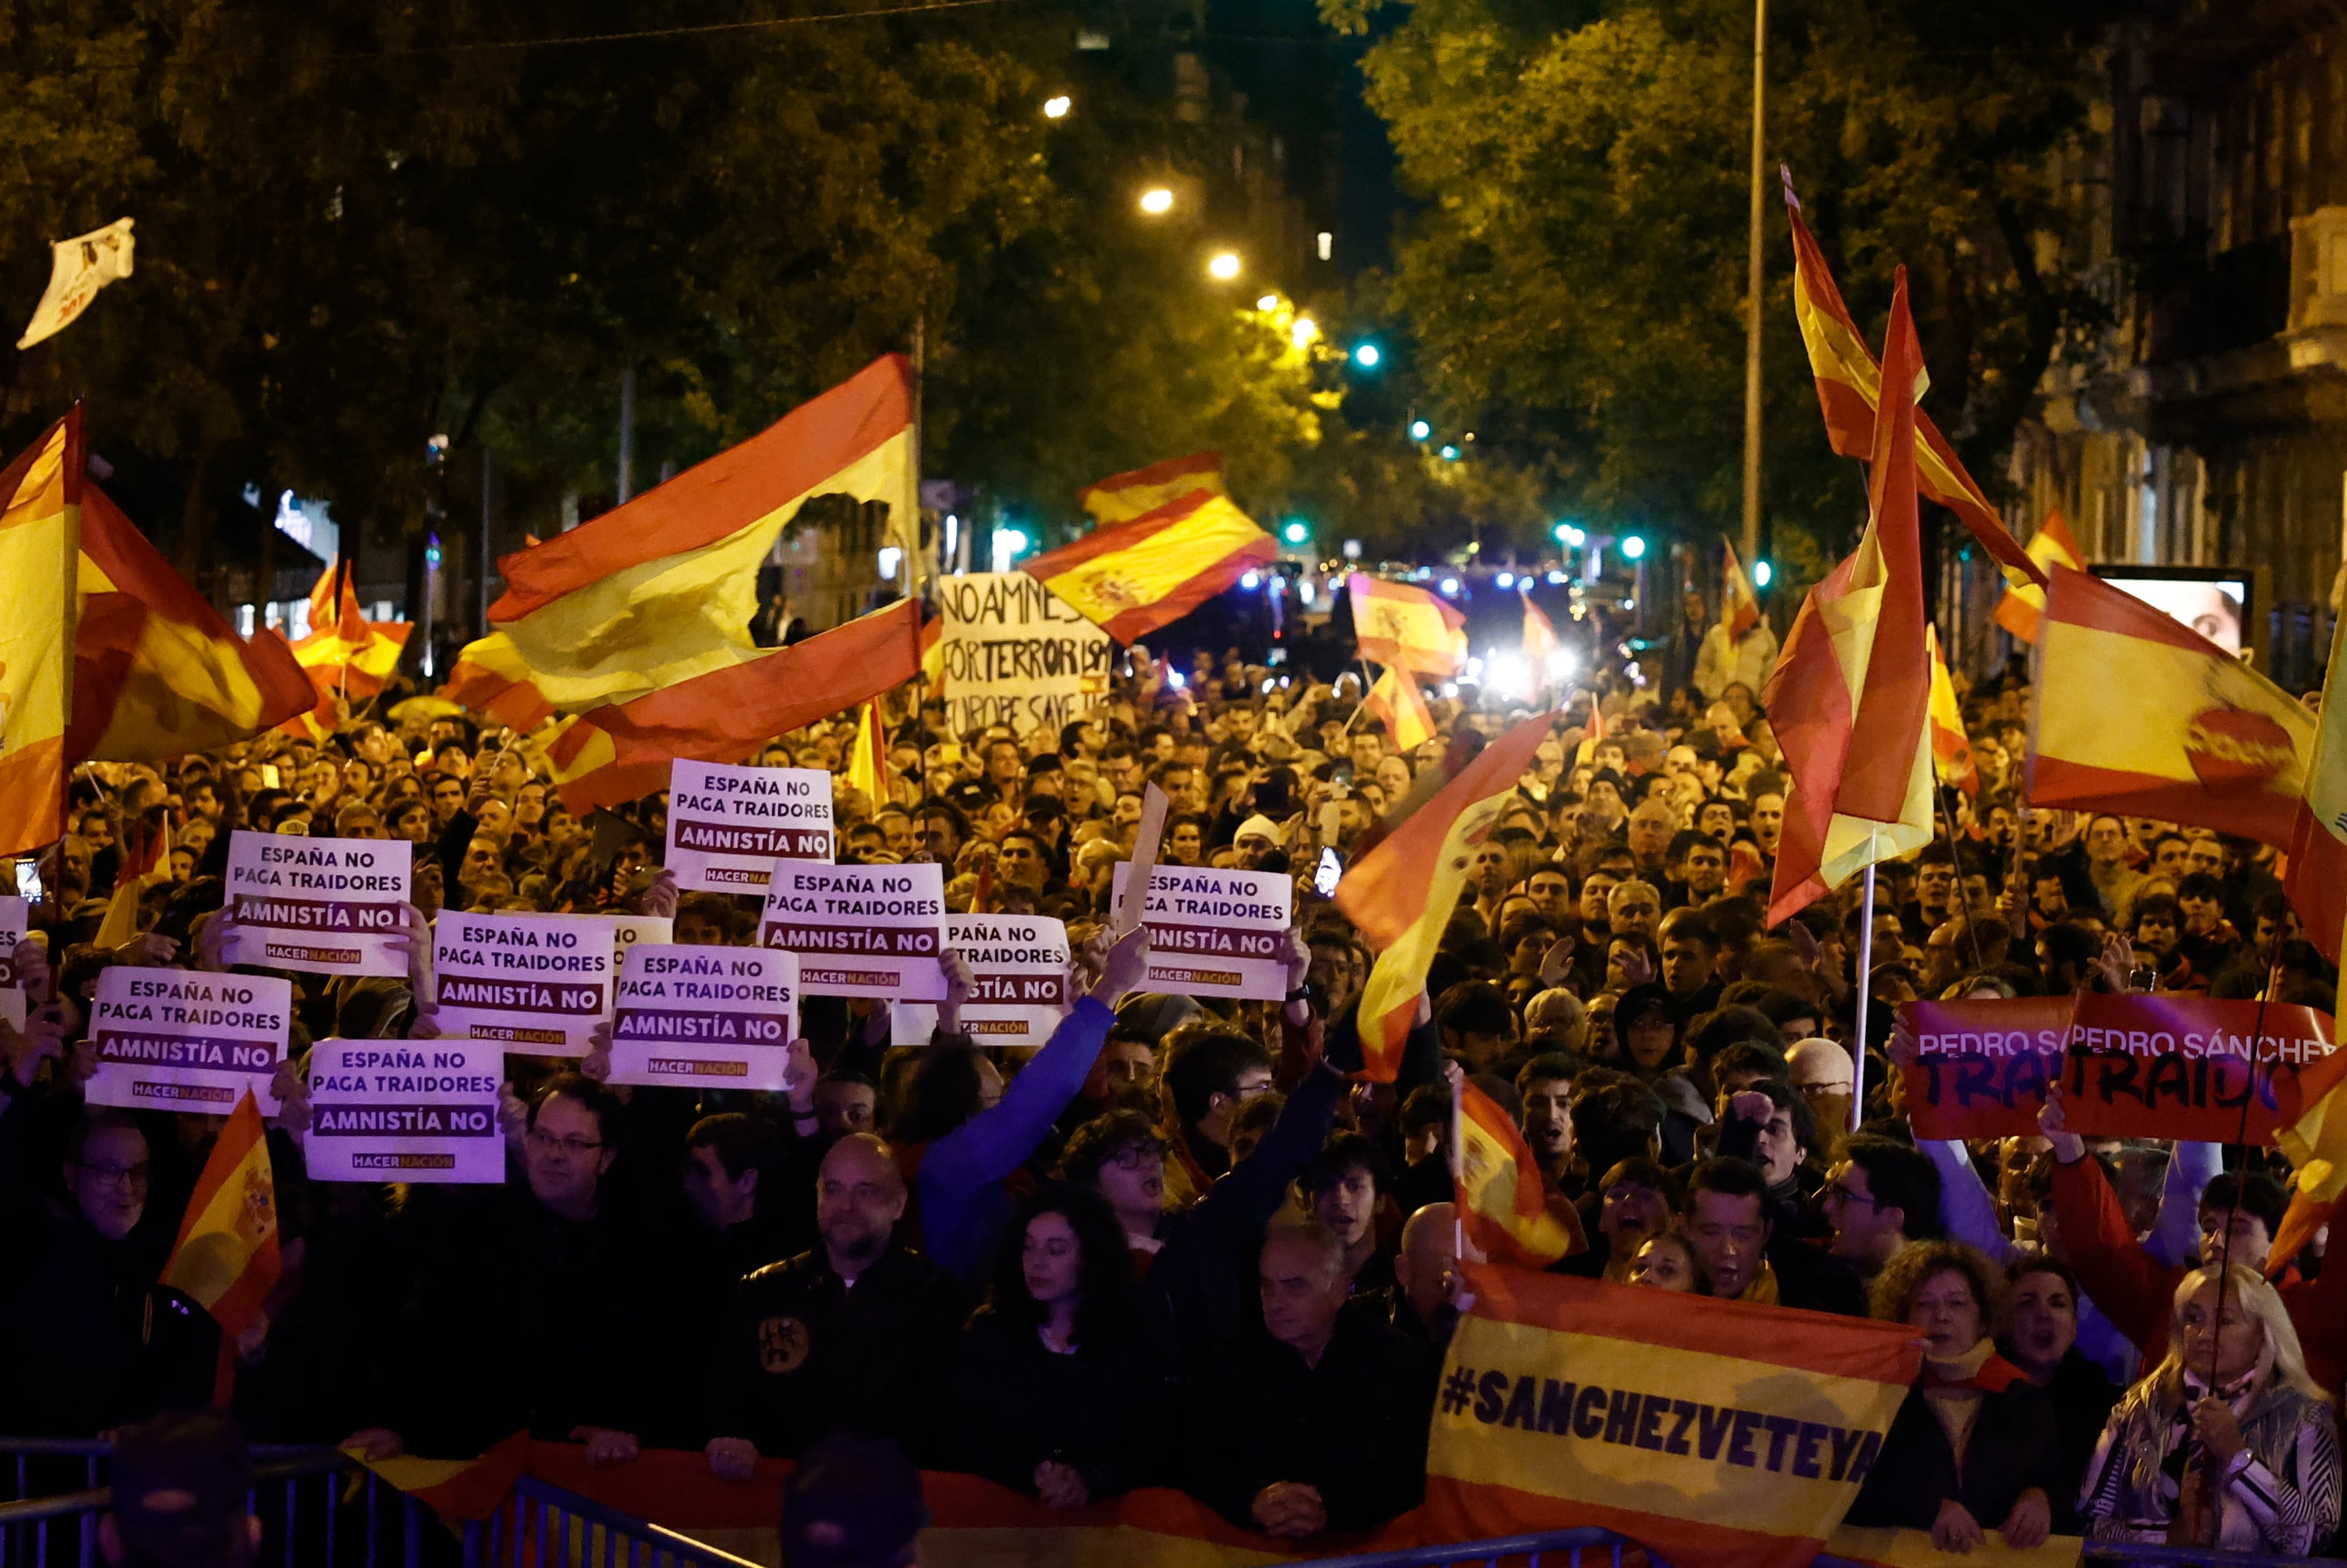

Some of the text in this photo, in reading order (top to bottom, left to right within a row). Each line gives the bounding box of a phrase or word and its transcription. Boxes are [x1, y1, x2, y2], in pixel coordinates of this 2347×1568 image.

[942, 583, 979, 624] NO
[705, 775, 810, 796] ESPAÑA NO
[677, 793, 829, 819] PAGA TRAIDORES
[680, 827, 826, 853] AMNISTÍA NO
[262, 846, 374, 868] ESPAÑA NO
[234, 867, 401, 891] PAGA TRAIDORES
[707, 870, 771, 883] HACERNA
[794, 874, 912, 893] ESPAÑA NO
[1148, 876, 1258, 896] ESPAÑA NO
[238, 902, 394, 927] AMNISTÍA NO
[767, 893, 939, 916] PAGA TRAIDORES
[1176, 899, 1283, 920] TRAIDORES
[463, 926, 577, 948] ESPAÑA NO
[769, 928, 933, 951] AMNISTÍA NO
[949, 923, 1036, 941] PAÑA NO
[1151, 928, 1274, 954] NISTÍA NO
[439, 946, 484, 966] PAGA
[491, 951, 605, 971] TRAIDORES
[644, 955, 723, 976] ESPAÑA
[731, 961, 763, 977] NO
[957, 949, 1064, 964] TRAIDORES
[130, 981, 253, 1004] ESPAÑA NO
[441, 981, 597, 1009] AMNISTÍA NO
[619, 981, 791, 1003] PAGA TRAIDORES
[1024, 981, 1058, 999] NO
[99, 1002, 280, 1030] PAGA TRAIDORES
[619, 1014, 781, 1039] AMNISTÍA NO
[1919, 1031, 2029, 1058] PEDRO
[2072, 1024, 2175, 1057] PEDRO
[102, 1038, 270, 1067] AMNISTÍA NO
[342, 1049, 465, 1068] ESPAÑA NO
[313, 1076, 495, 1092] PAGA TRAIDORES
[319, 1107, 487, 1131] AMNISTÍA NO
[1441, 1366, 1883, 1484] #SANCHEZVETEYA
